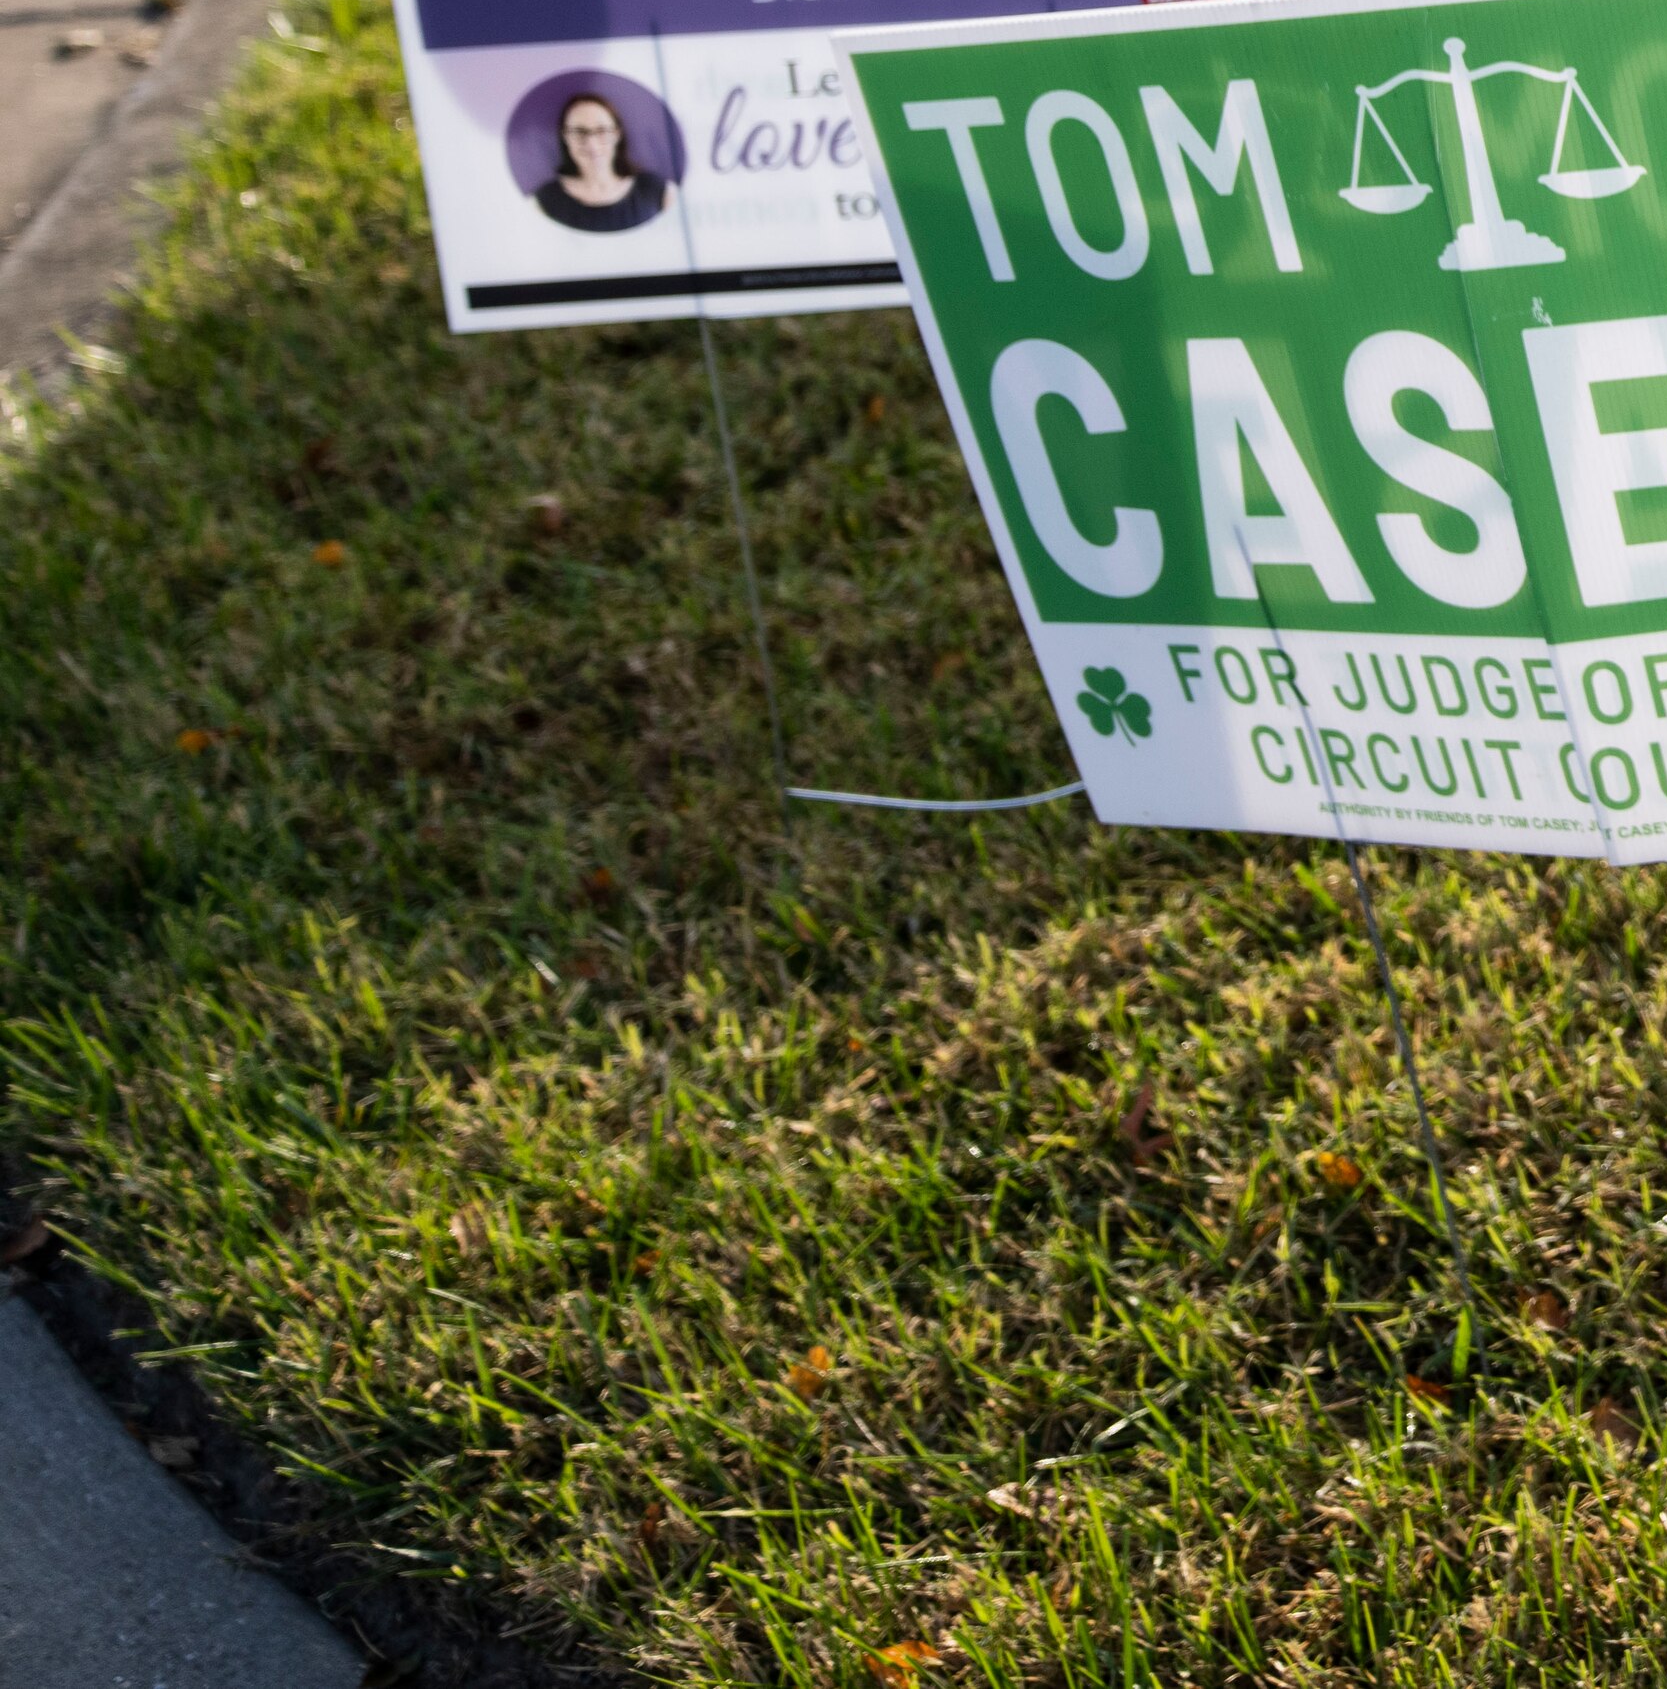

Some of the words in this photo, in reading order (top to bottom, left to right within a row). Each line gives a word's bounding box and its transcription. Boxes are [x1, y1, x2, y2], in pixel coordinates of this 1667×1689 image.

[902, 79, 1303, 281] TOM
[1167, 644, 1310, 706] FOR
[1333, 653, 1567, 721] JUDGE
[1251, 725, 1522, 801] CIRCUIT
[1319, 801, 1391, 819] AUTHORITY
[1396, 808, 1411, 820] BY
[1416, 810, 1474, 825] FRIENDS
[1478, 812, 1495, 826] OF
[1499, 814, 1528, 828] TOM
